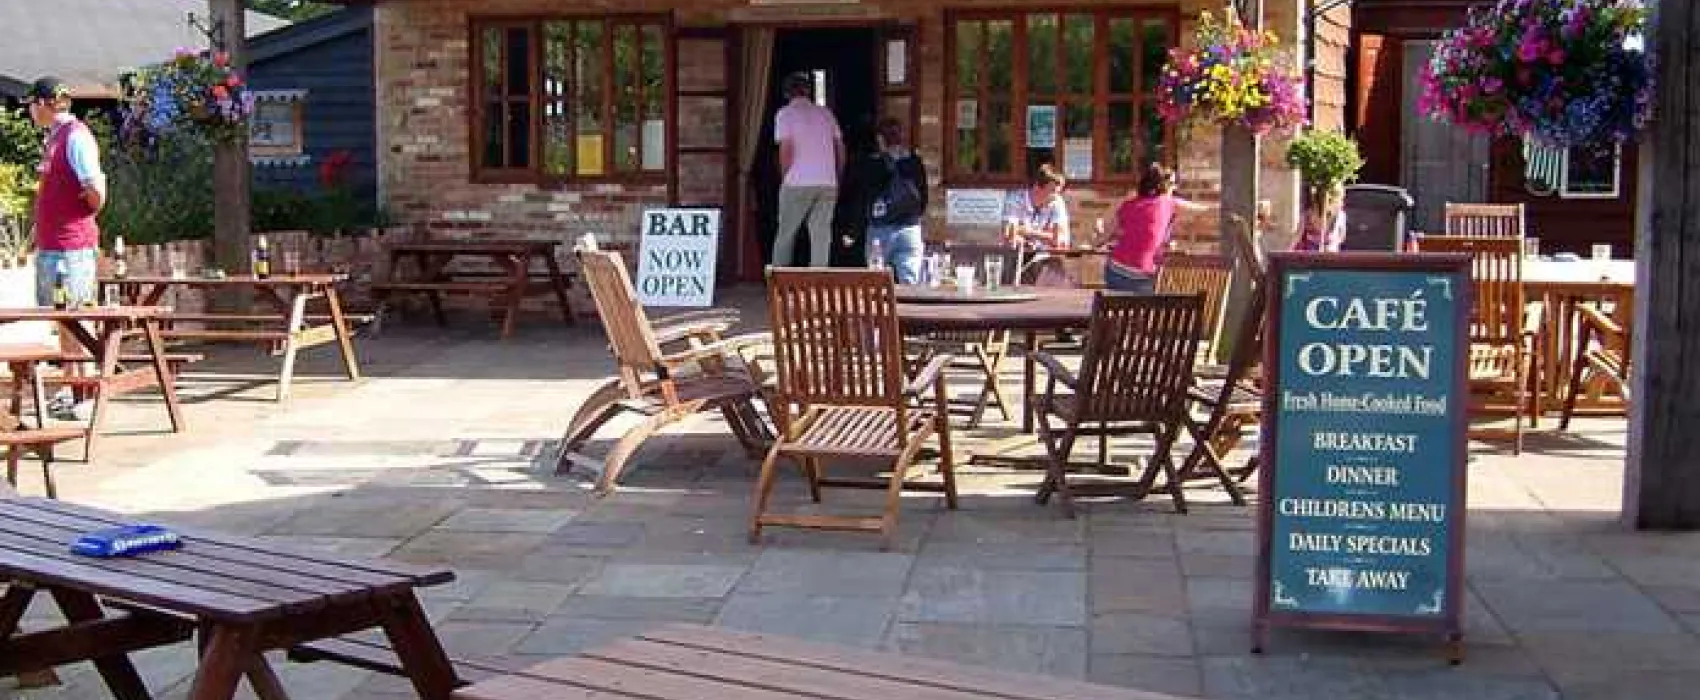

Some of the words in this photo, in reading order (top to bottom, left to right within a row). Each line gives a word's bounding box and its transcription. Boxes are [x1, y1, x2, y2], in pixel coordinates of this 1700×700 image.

[646, 212, 712, 235] BAR
[648, 249, 708, 270] NOW
[642, 274, 707, 296] OPEN
[1305, 288, 1428, 331] CAFÉ
[1298, 342, 1434, 379] OPEN
[1415, 394, 1447, 416] Food
[1312, 432, 1419, 452] BREAKFAST
[1327, 465, 1399, 486] DINNER
[1279, 498, 1385, 519] CHILDRENS
[1388, 502, 1447, 522] MENU
[1289, 532, 1342, 553] DAILY
[1346, 534, 1432, 556] SPECIALS
[1305, 566, 1353, 588] TAKE
[1356, 569, 1412, 590] AWAY
